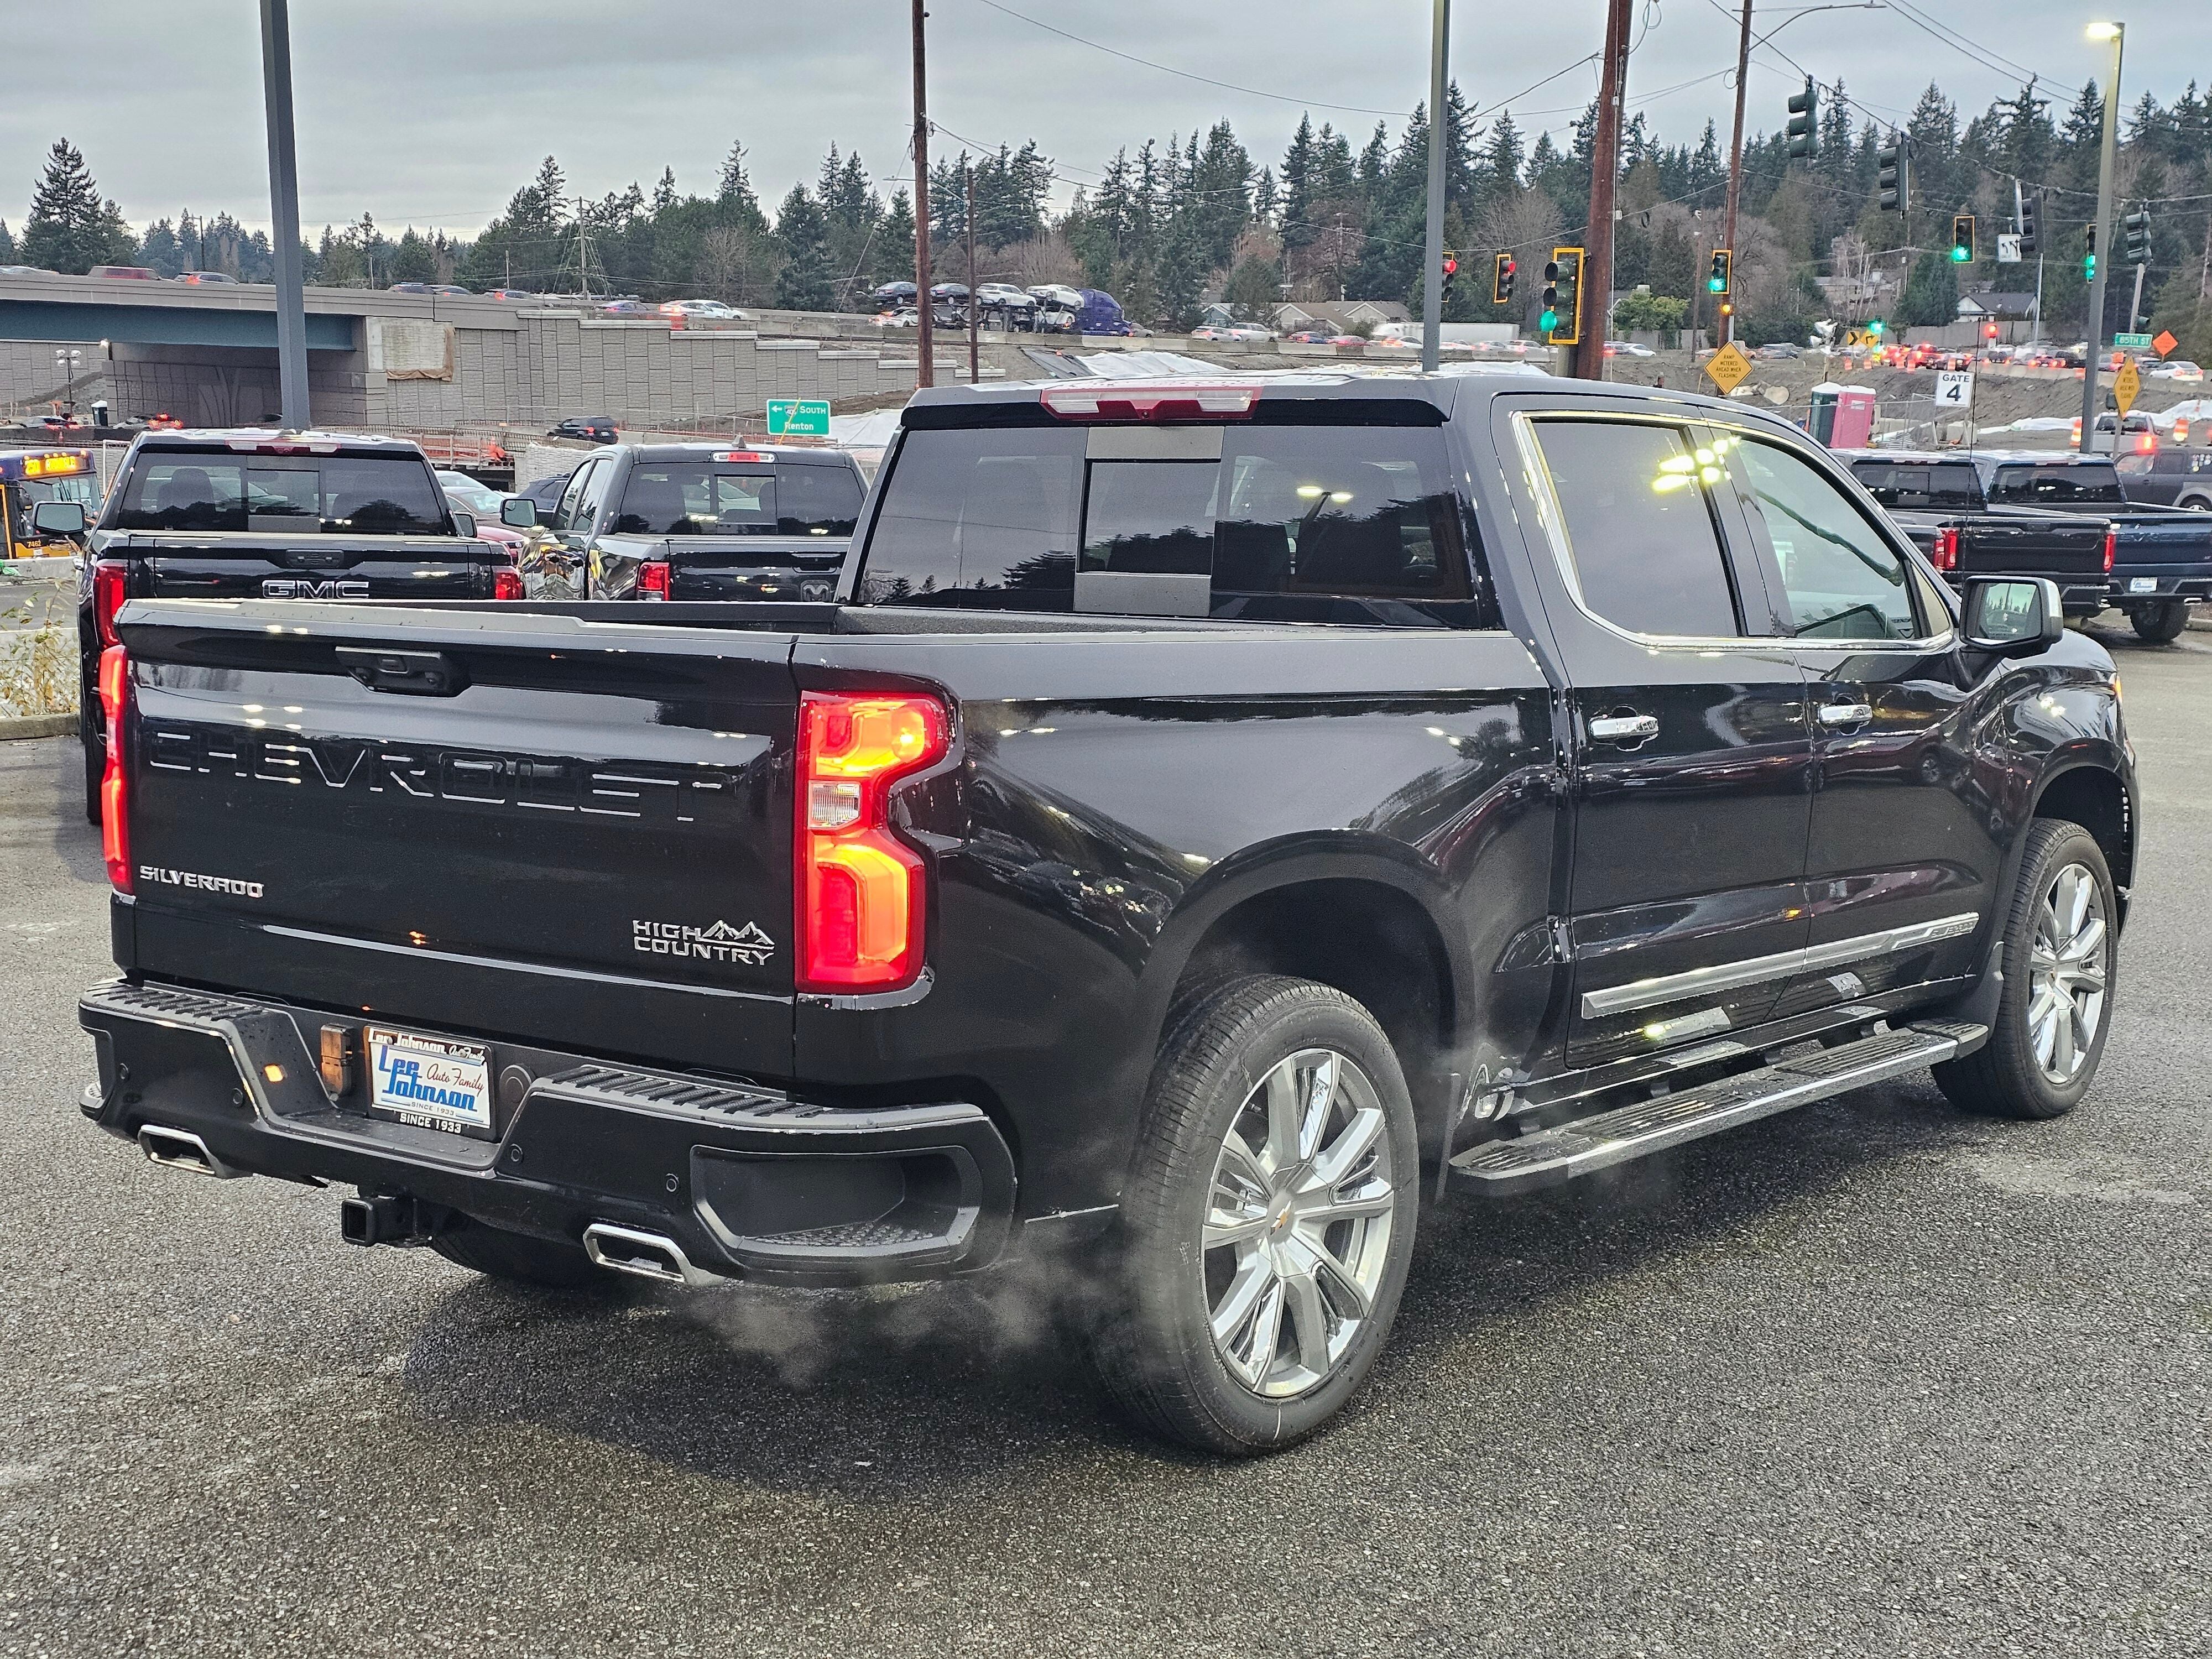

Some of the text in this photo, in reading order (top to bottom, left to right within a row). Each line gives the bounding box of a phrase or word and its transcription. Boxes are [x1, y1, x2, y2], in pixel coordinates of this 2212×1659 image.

[2141, 337, 2151, 345] ST
[1942, 374, 1970, 383] GATE
[1947, 384, 1961, 401] 4
[800, 405, 826, 414] SOUTH
[785, 421, 814, 430] Renton
[27, 539, 42, 548] 7462
[262, 580, 369, 599] GMC
[148, 729, 724, 822] CHEVROLET
[140, 865, 264, 898] SILVERADO
[633, 920, 701, 942] HIGH
[634, 936, 774, 966] COUNTRY
[394, 1032, 447, 1054] Johnson
[379, 1045, 422, 1079] Lee
[427, 1063, 484, 1097] Auto Family
[382, 1072, 478, 1112] Johnson
[411, 1102, 455, 1116] SINCE 1933
[399, 1113, 462, 1134] SINCE 1933
